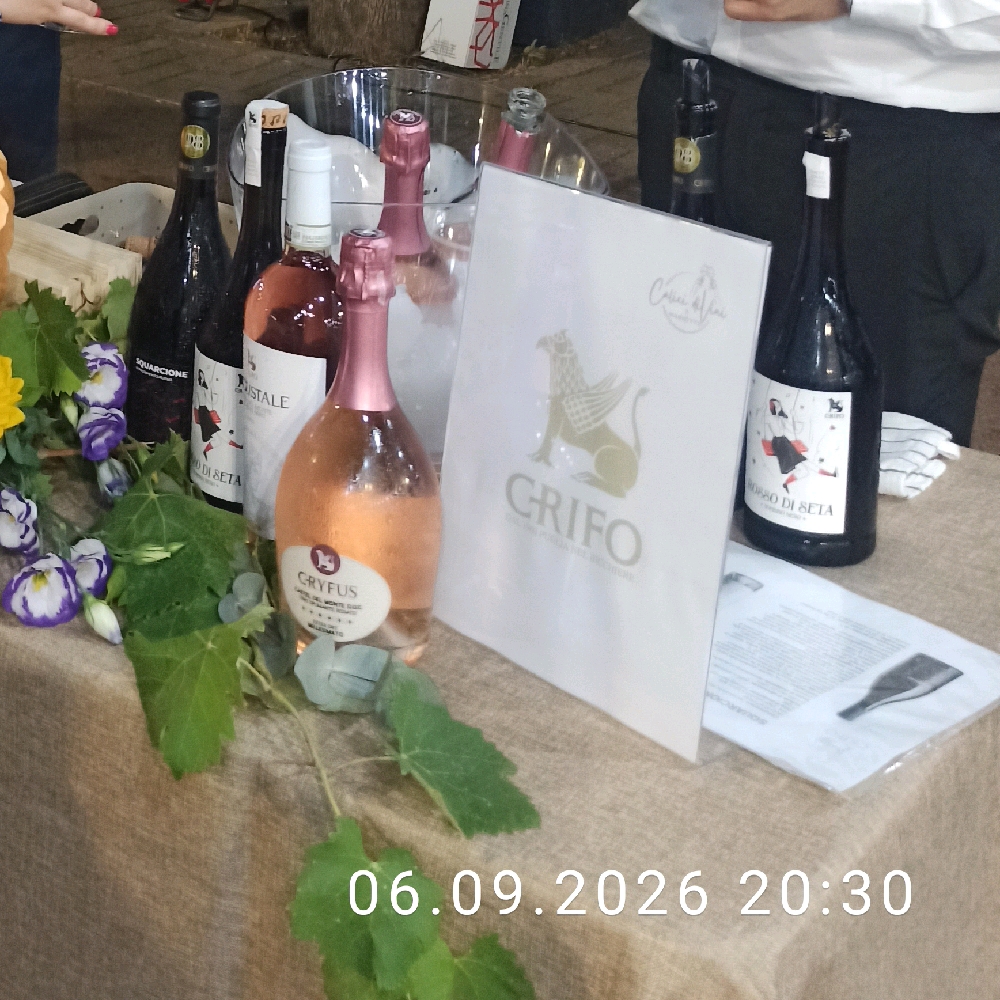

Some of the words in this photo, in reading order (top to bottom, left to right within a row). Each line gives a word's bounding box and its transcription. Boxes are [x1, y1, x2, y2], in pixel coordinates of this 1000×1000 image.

[135, 357, 188, 379] SQUARCIONE
[213, 468, 242, 487] SETA
[747, 477, 779, 504] ROSSO
[781, 497, 795, 511] DI
[798, 500, 834, 516] SETA
[505, 473, 643, 567] GRIFO
[297, 571, 358, 599] GRYFUS
